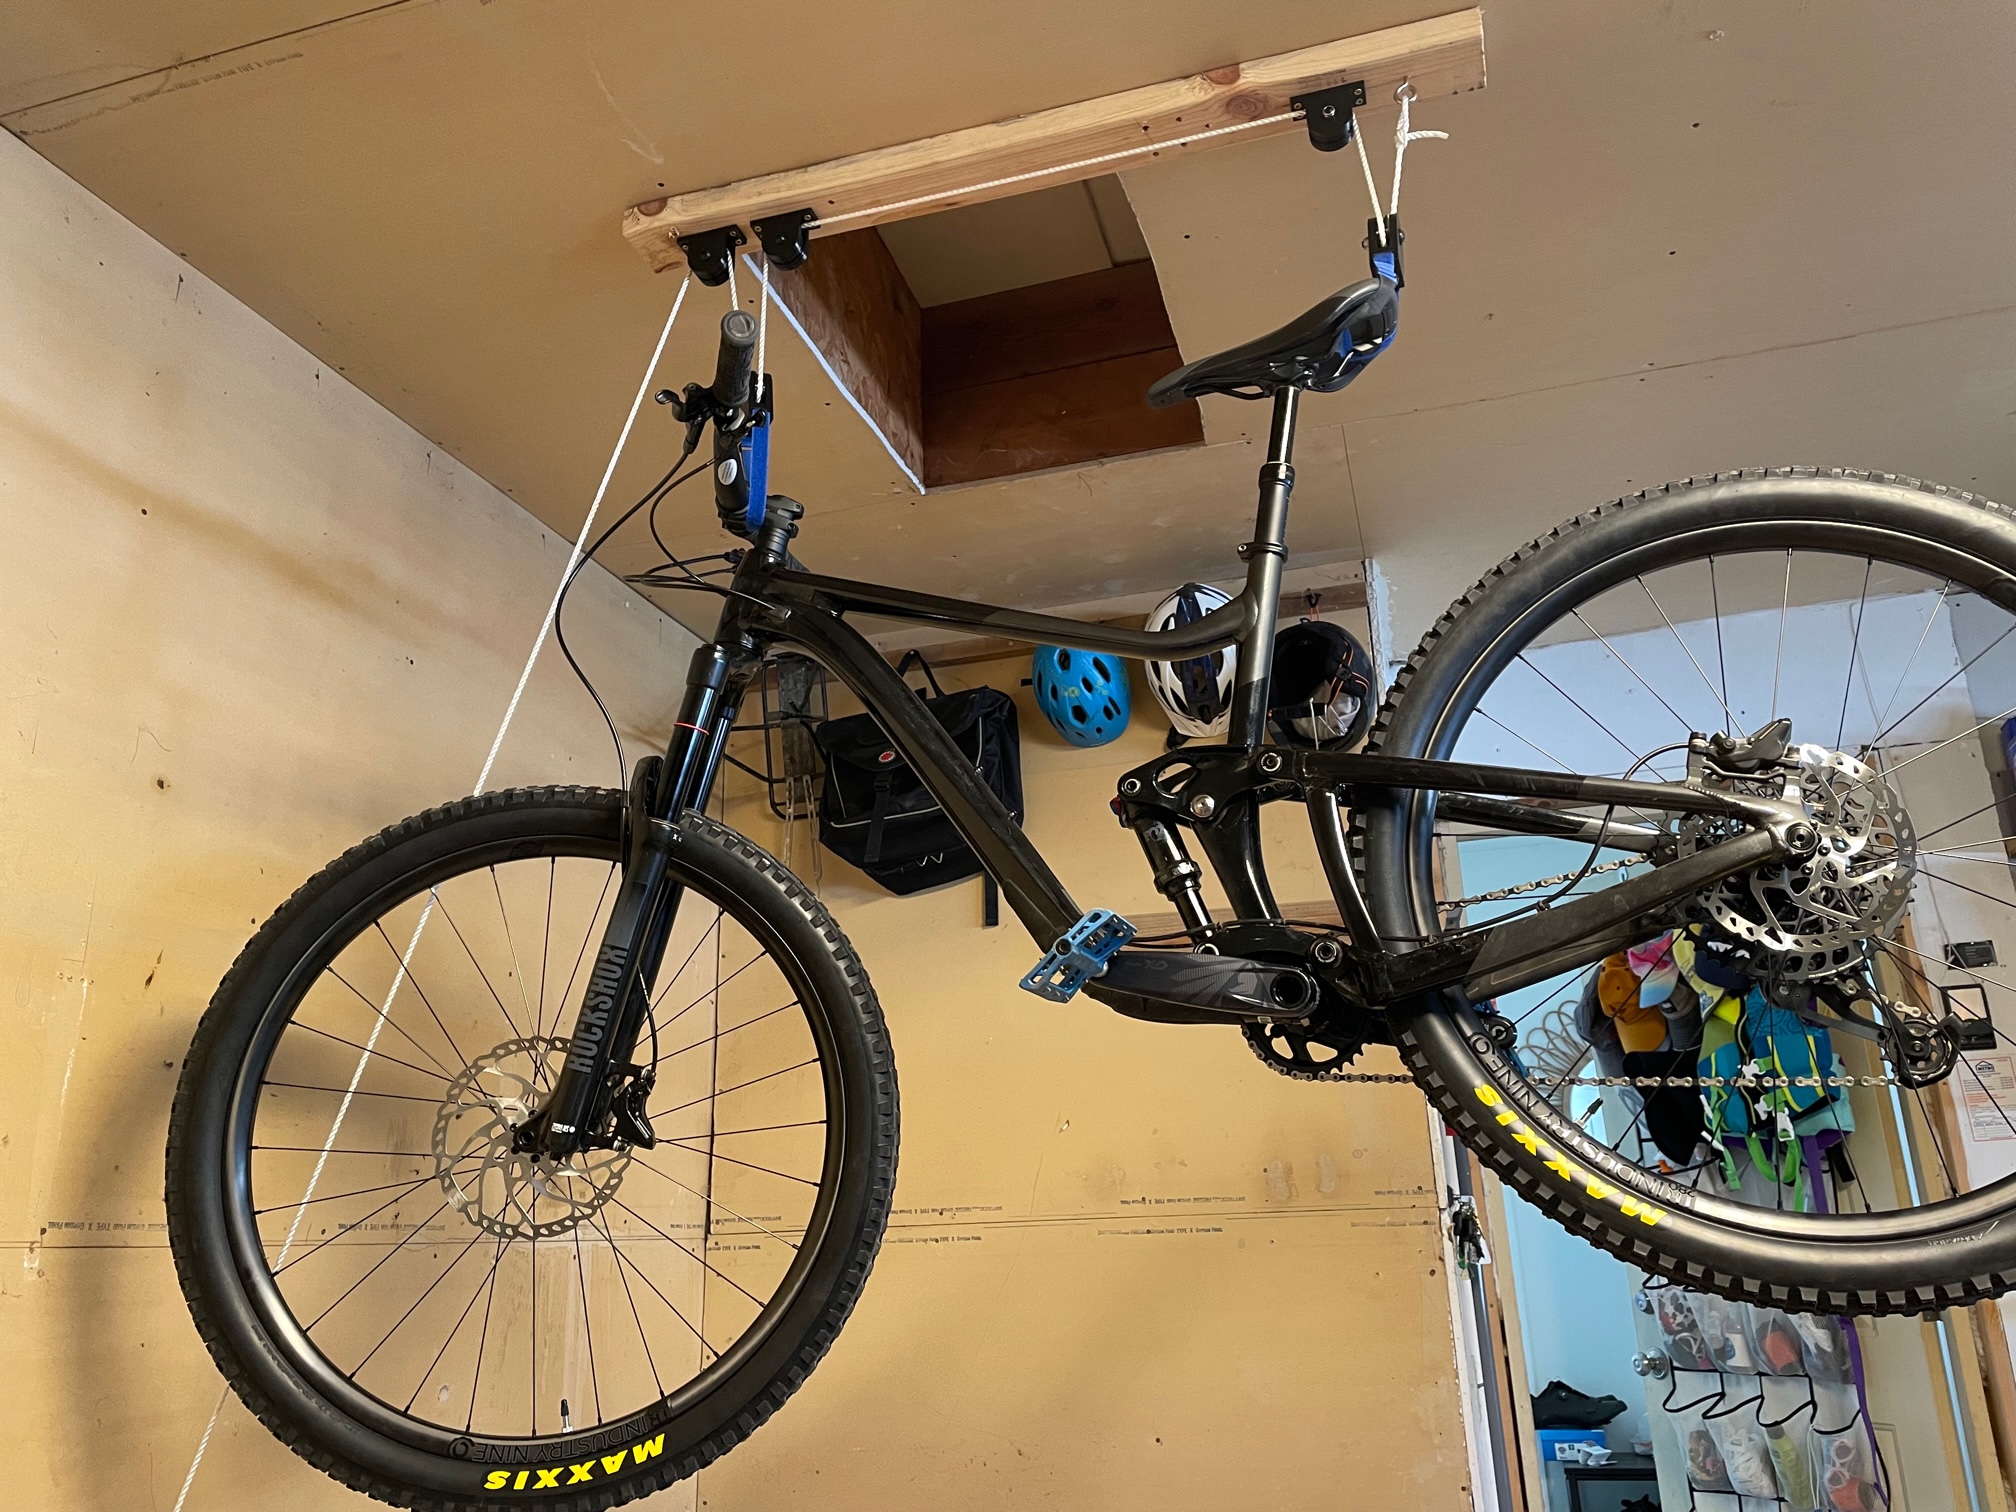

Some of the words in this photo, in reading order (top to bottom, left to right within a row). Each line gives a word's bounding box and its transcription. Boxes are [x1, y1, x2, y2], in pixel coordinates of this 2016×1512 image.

[1484, 1054, 1540, 1111] NINE
[1474, 1083, 1668, 1226] MAXXIS
[1535, 1110, 1664, 1200] INDUSTRY
[472, 1442, 530, 1464] NINE
[483, 1432, 665, 1490] MAXXIS
[534, 1414, 649, 1461] INDUSTRY
